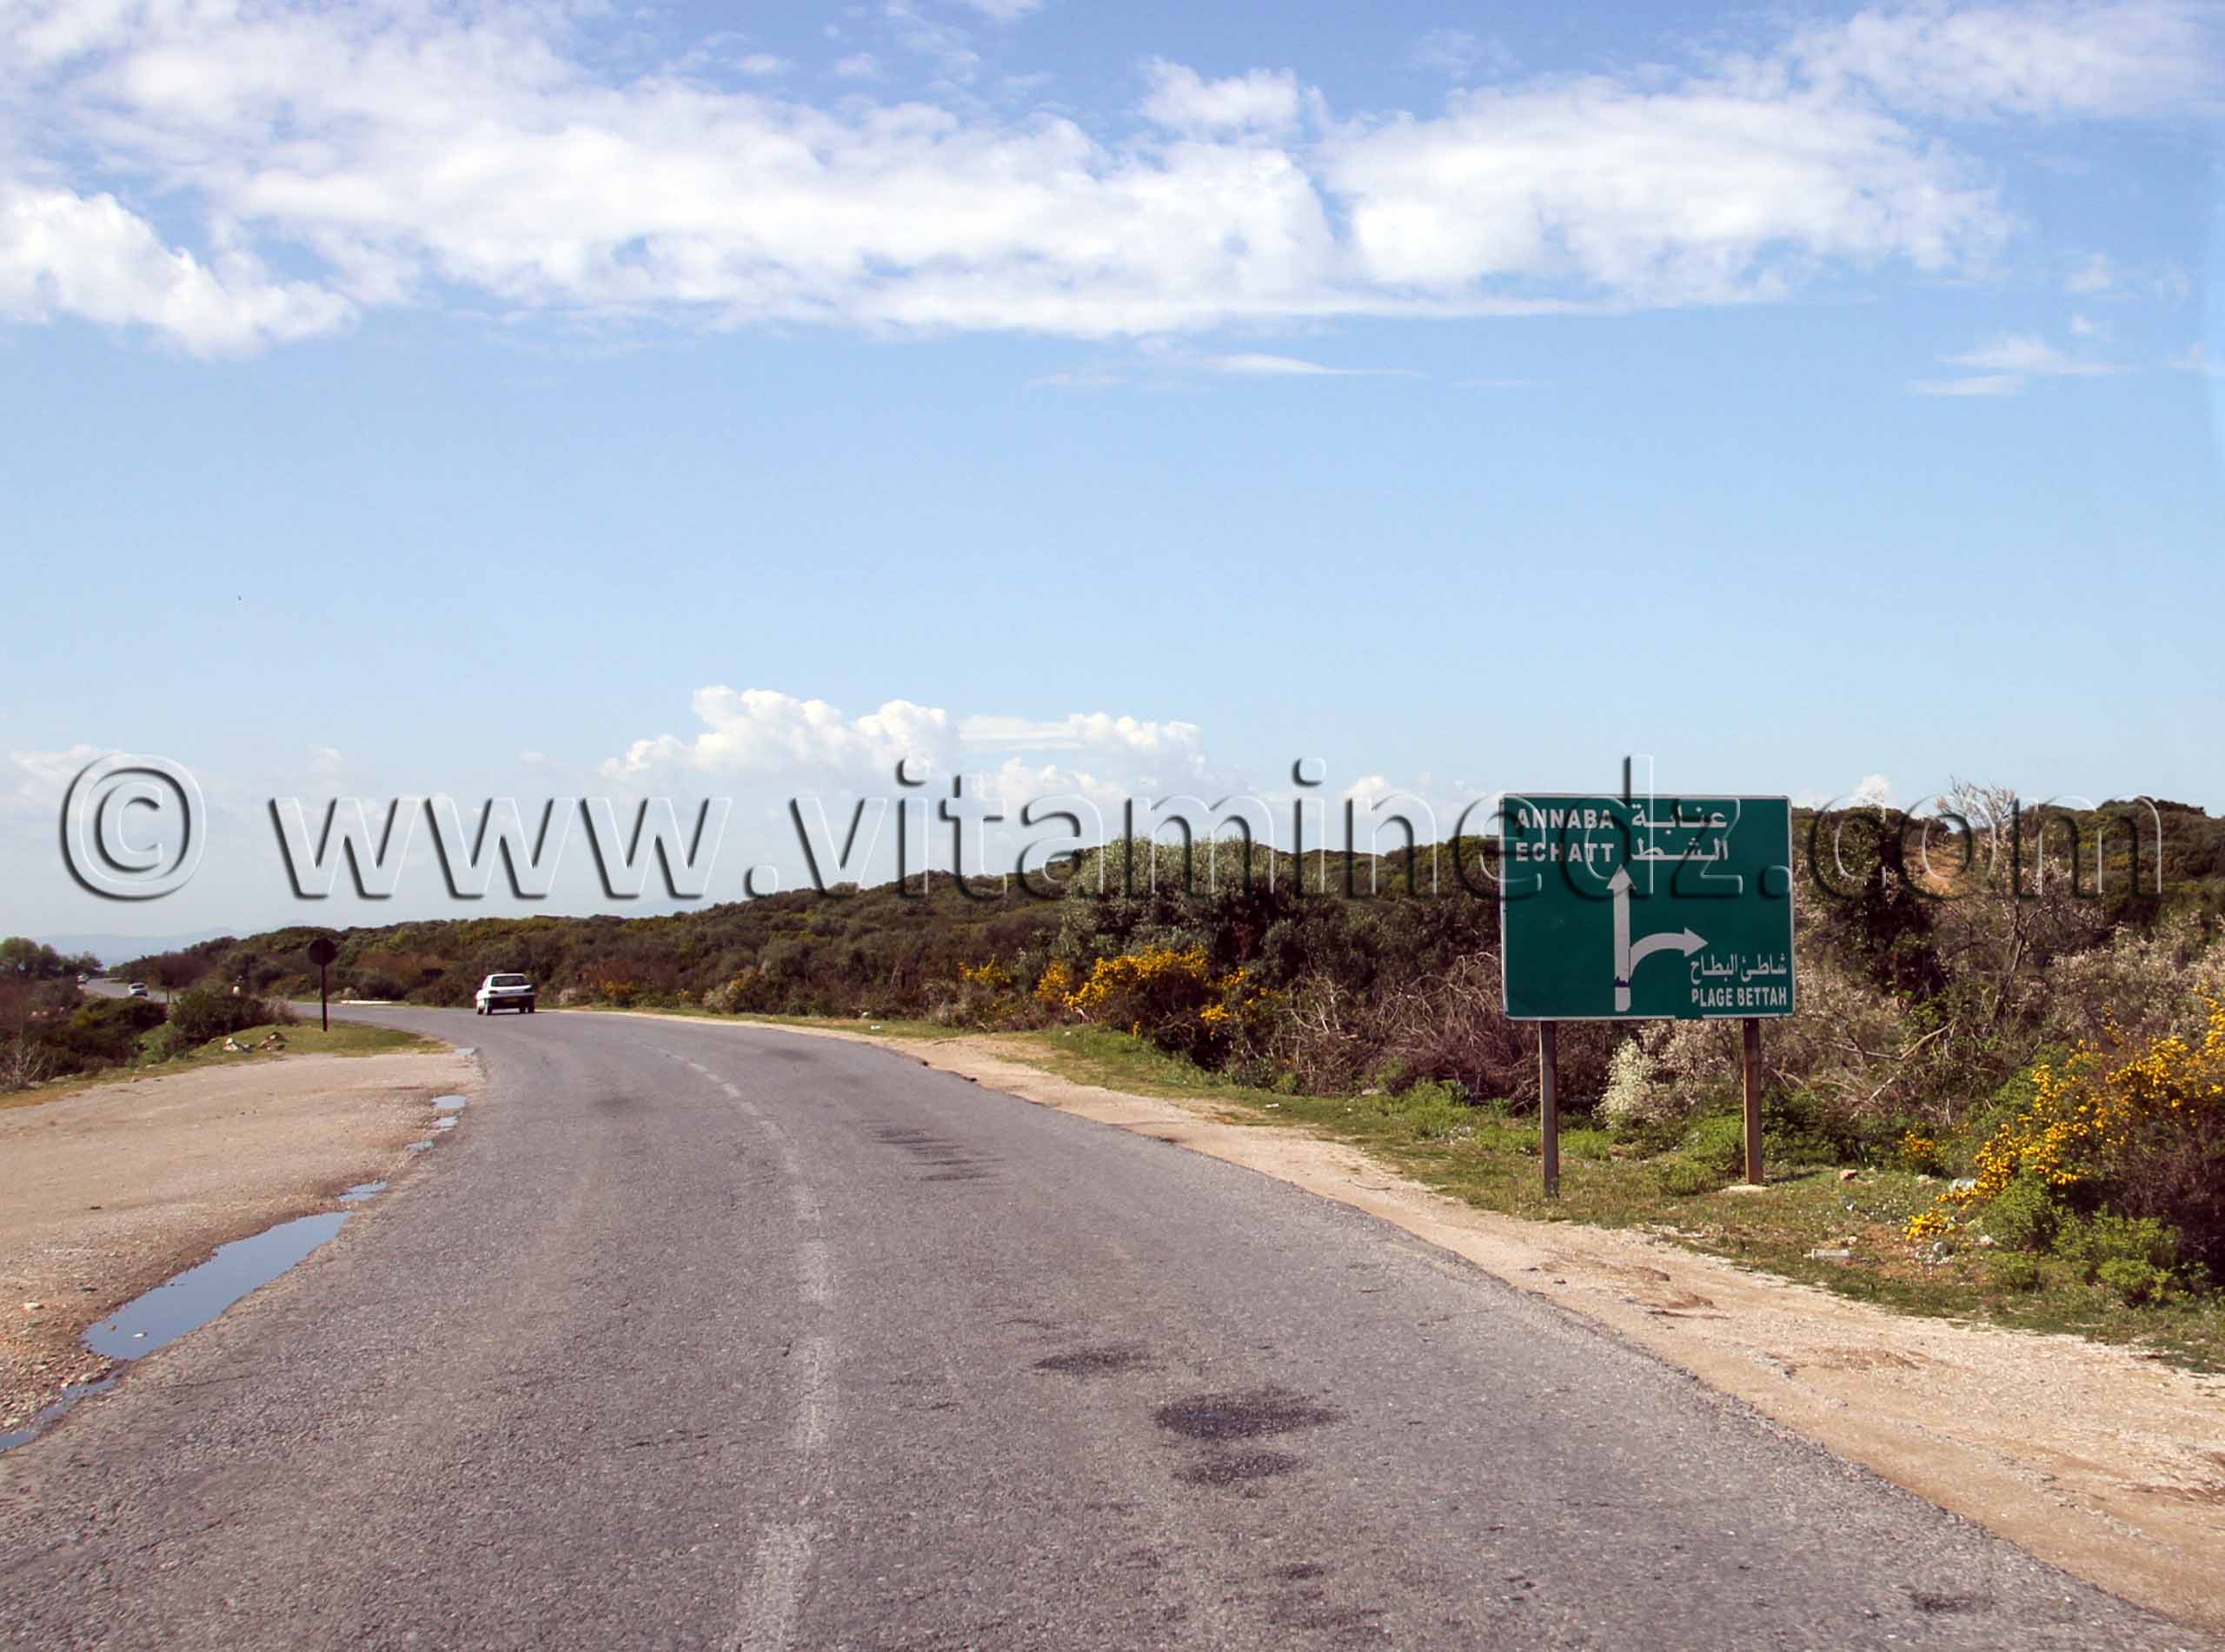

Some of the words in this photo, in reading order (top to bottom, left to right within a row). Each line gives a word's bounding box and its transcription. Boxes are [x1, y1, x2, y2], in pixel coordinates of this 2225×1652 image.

[1516, 808, 1614, 829] ANNABA
[1631, 802, 1727, 835] عنابة
[1515, 842, 1614, 862] ECHATT
[1631, 837, 1729, 860] الشط
[1690, 953, 1738, 985] البطاح
[1691, 987, 1734, 1007] PLAGE
[1737, 986, 1787, 1006] BETTAH
